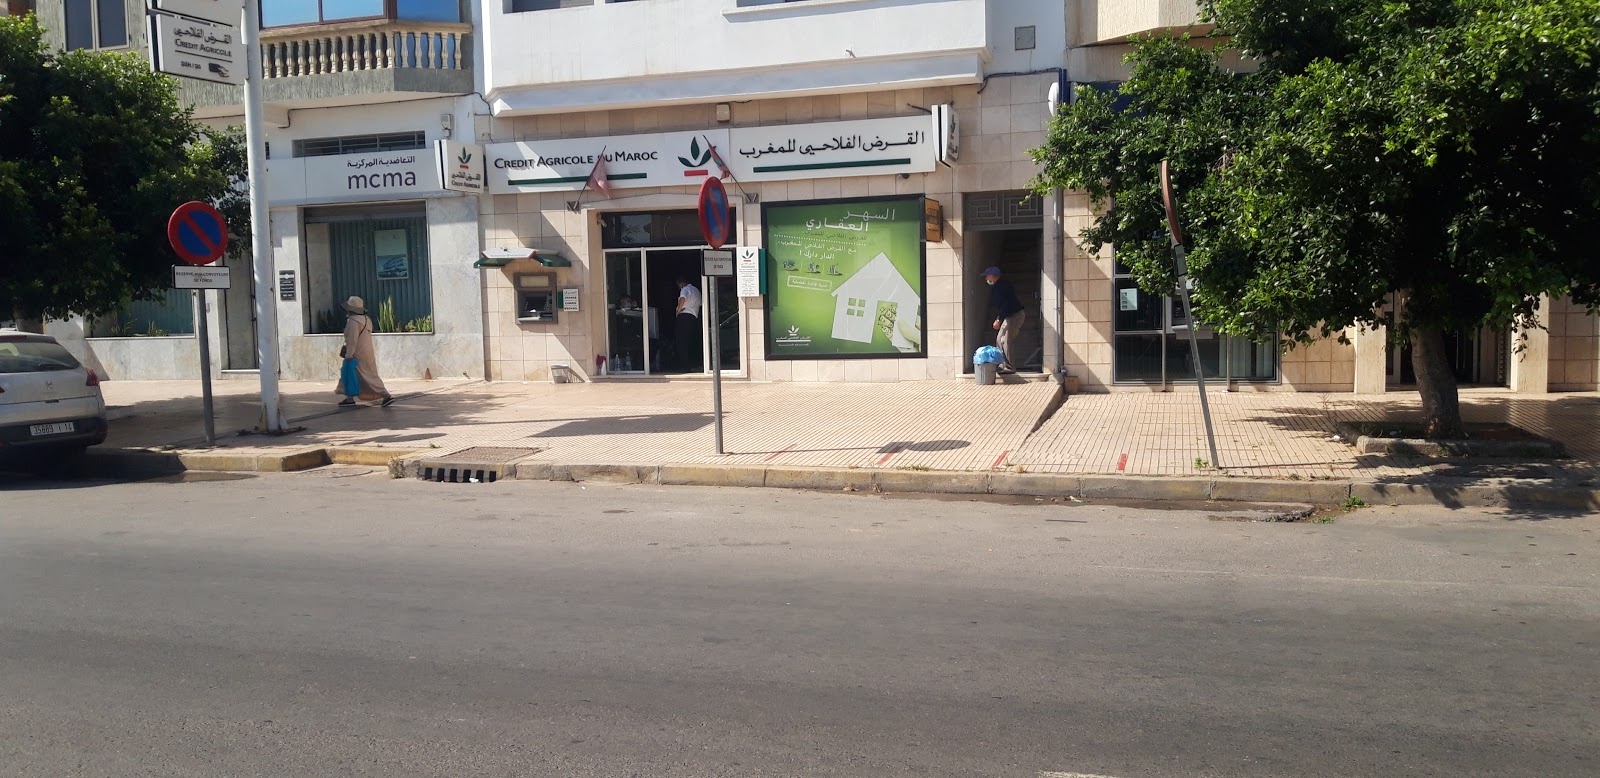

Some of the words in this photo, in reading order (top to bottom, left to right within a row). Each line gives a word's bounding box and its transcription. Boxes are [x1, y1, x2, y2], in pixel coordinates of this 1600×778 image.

[174, 38, 198, 50] CREDIT
[199, 43, 232, 57] AGRICOLE
[739, 138, 796, 158] للمغرب
[799, 135, 861, 156] الفلاحي
[862, 130, 924, 151] القرض
[347, 158, 378, 169] المركزية
[378, 156, 416, 167] التعاضدية
[494, 158, 534, 169] CREDIT
[536, 155, 594, 168] AGRICOLE
[615, 151, 658, 162] MAROC
[347, 170, 417, 190] mcma
[806, 217, 869, 232] العقاري
